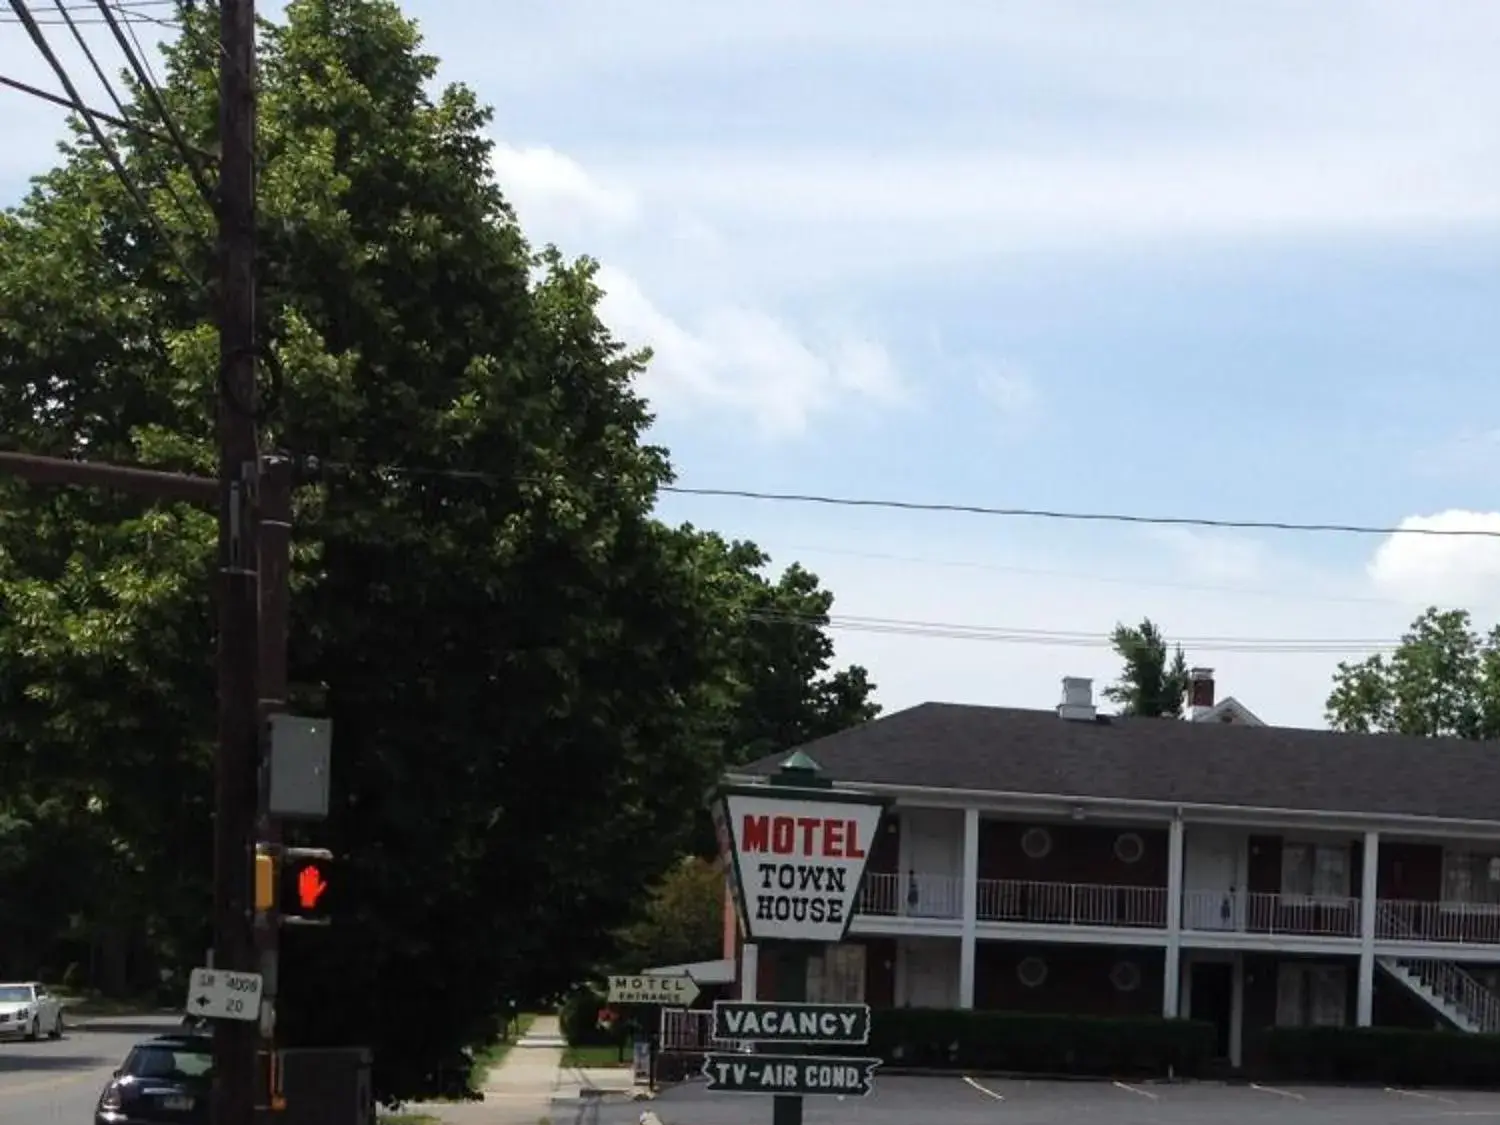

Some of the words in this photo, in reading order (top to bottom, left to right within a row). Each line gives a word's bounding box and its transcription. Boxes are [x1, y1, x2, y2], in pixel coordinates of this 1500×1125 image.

[741, 814, 865, 859] MOTEL
[759, 863, 847, 892] TOWN
[756, 895, 843, 923] HOUSE
[615, 977, 685, 991] MOTEL
[725, 1009, 857, 1036] VACANCY
[716, 1063, 797, 1087] TV-AIR
[805, 1065, 863, 1088] COND.
